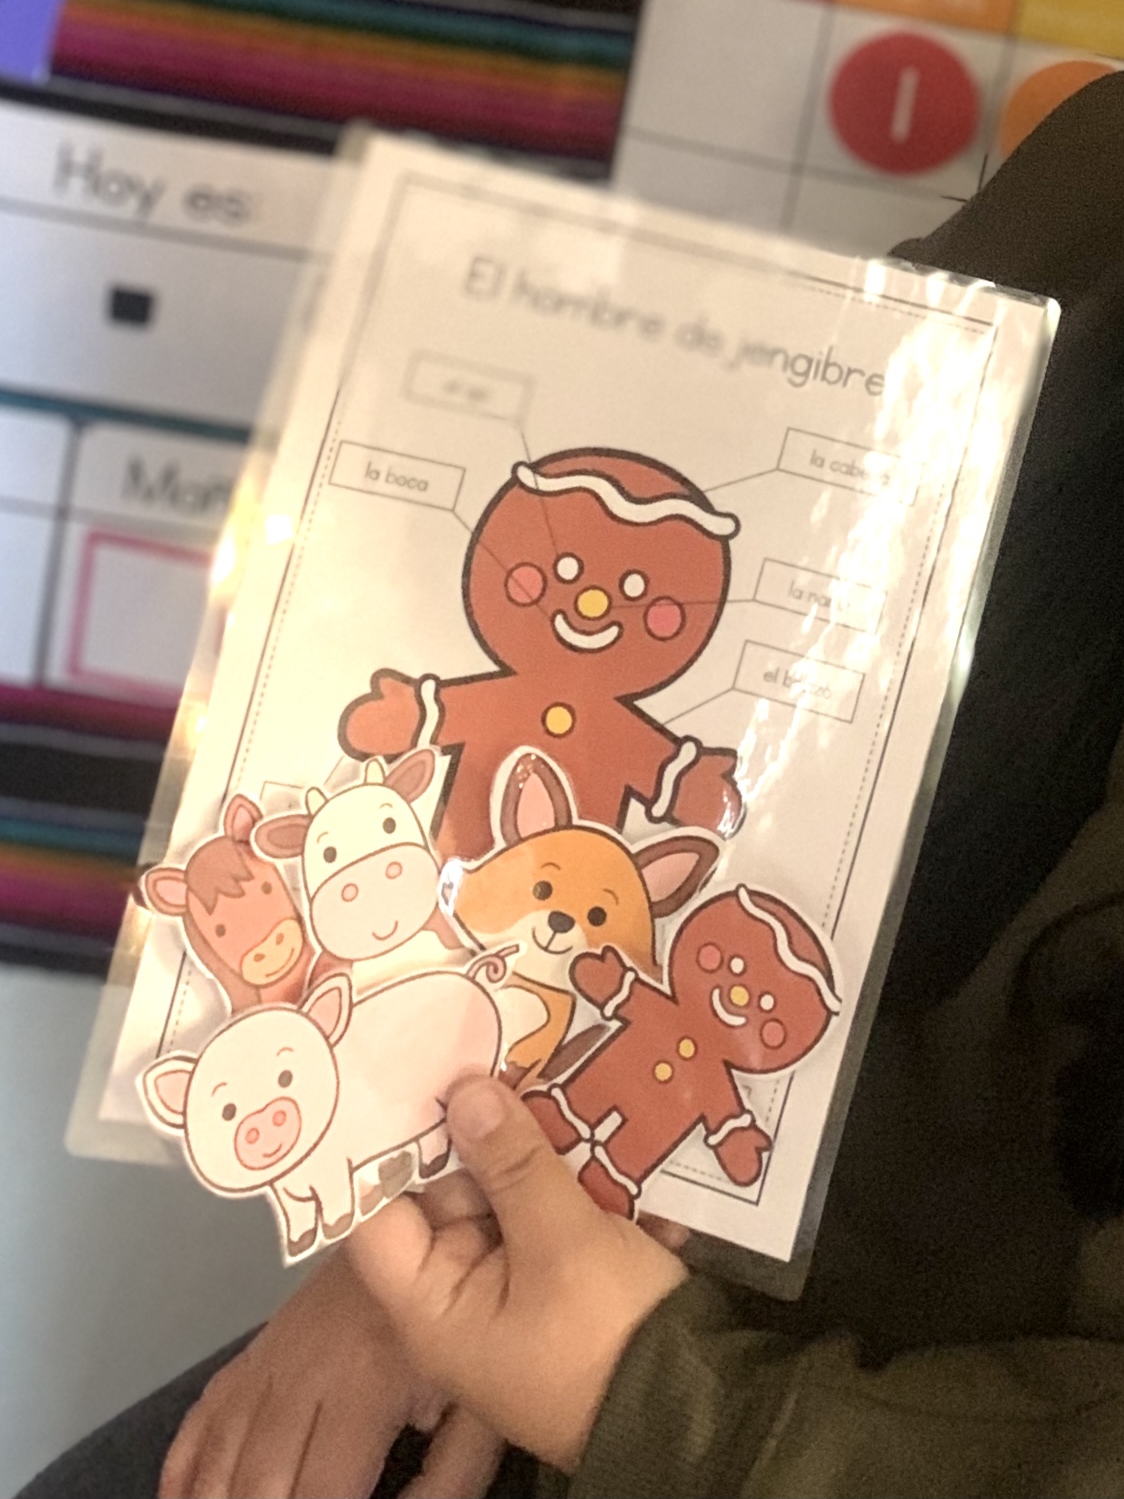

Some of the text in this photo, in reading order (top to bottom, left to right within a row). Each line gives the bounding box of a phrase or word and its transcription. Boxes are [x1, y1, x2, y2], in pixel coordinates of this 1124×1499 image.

[53, 140, 165, 220] Hoy
[464, 254, 884, 397] El hombre de jengibre
[365, 461, 430, 493] la boca
[808, 448, 891, 487] la cabea
[787, 579, 804, 601] la
[762, 667, 781, 684] el
